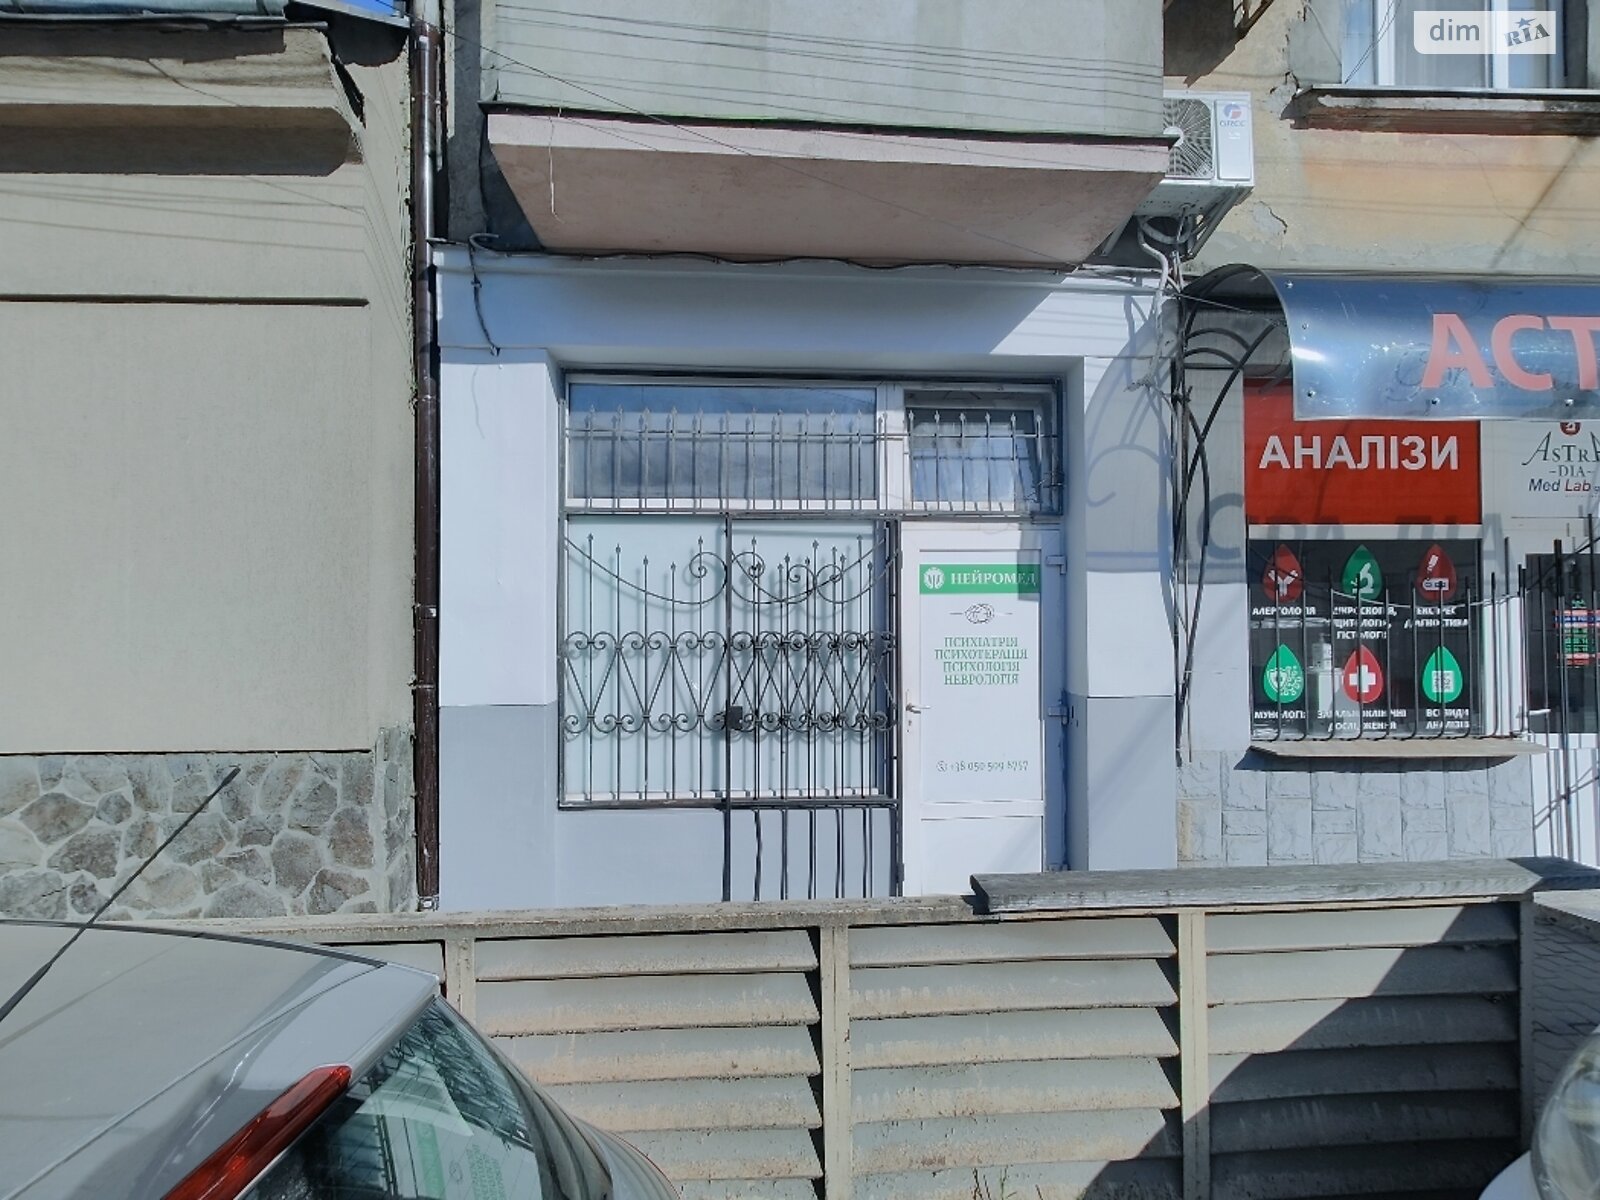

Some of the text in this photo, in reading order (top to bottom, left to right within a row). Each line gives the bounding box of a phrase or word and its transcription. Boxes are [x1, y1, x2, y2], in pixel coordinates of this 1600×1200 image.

[1259, 435, 1459, 470] АНАЛІЗИ
[1529, 478, 1560, 492] Med
[1565, 478, 1591, 492] Lab
[951, 569, 1036, 586] НЕЙРОМЕД
[944, 636, 1018, 648] ПСИХІАТРІЯ
[934, 649, 1028, 660] ПСИХОТЕРАПІЯ
[943, 661, 1020, 673] ПСИХОЛОГІЯ
[944, 673, 1019, 686] НЕВРОЛОГІЯ
